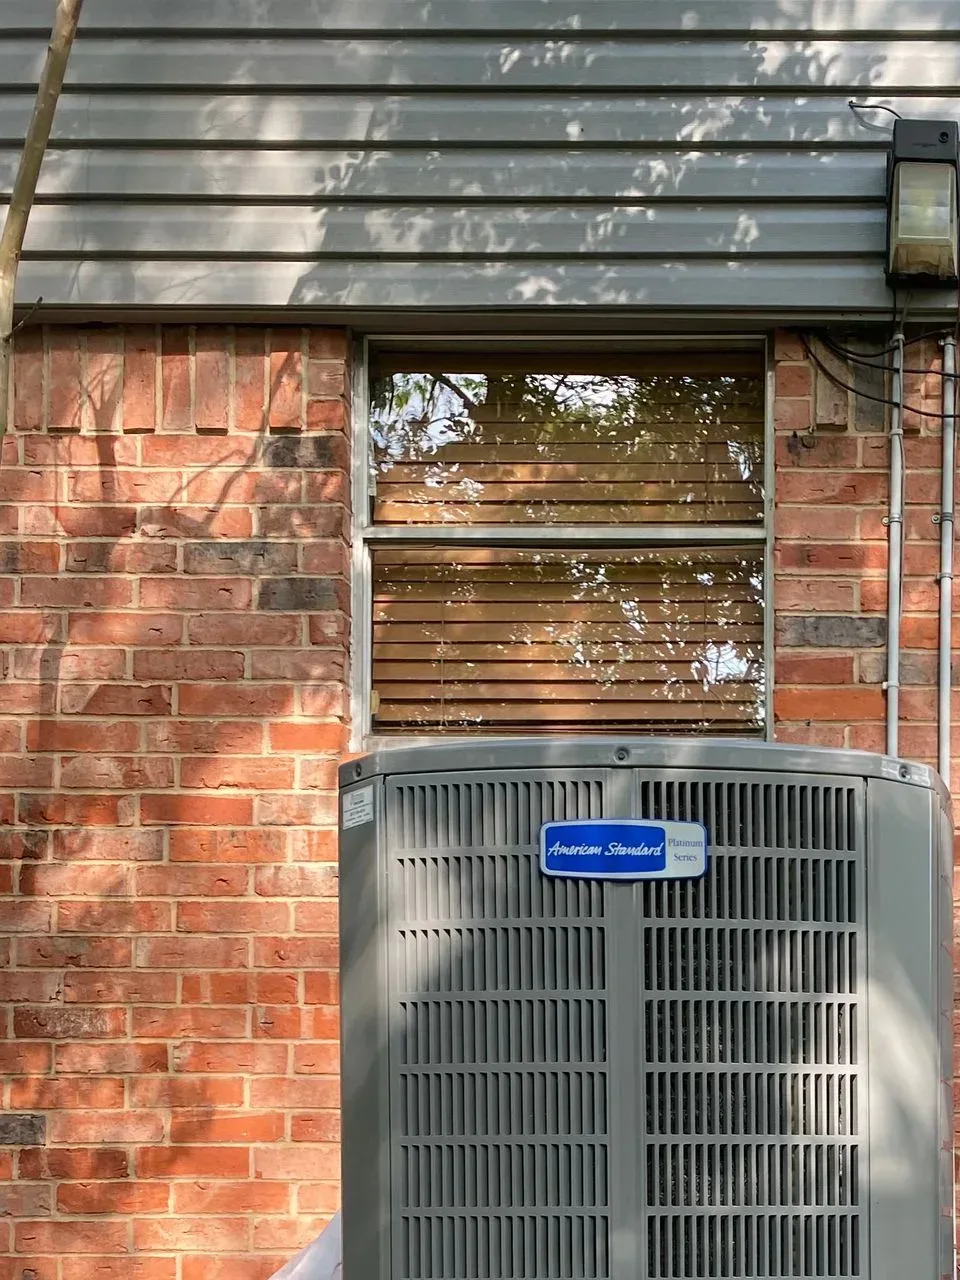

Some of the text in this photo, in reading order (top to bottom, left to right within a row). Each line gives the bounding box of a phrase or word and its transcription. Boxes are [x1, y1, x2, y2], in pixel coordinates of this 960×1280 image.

[547, 840, 664, 856] American Standard
[668, 838, 703, 848] Platinum
[673, 853, 698, 862] Series
